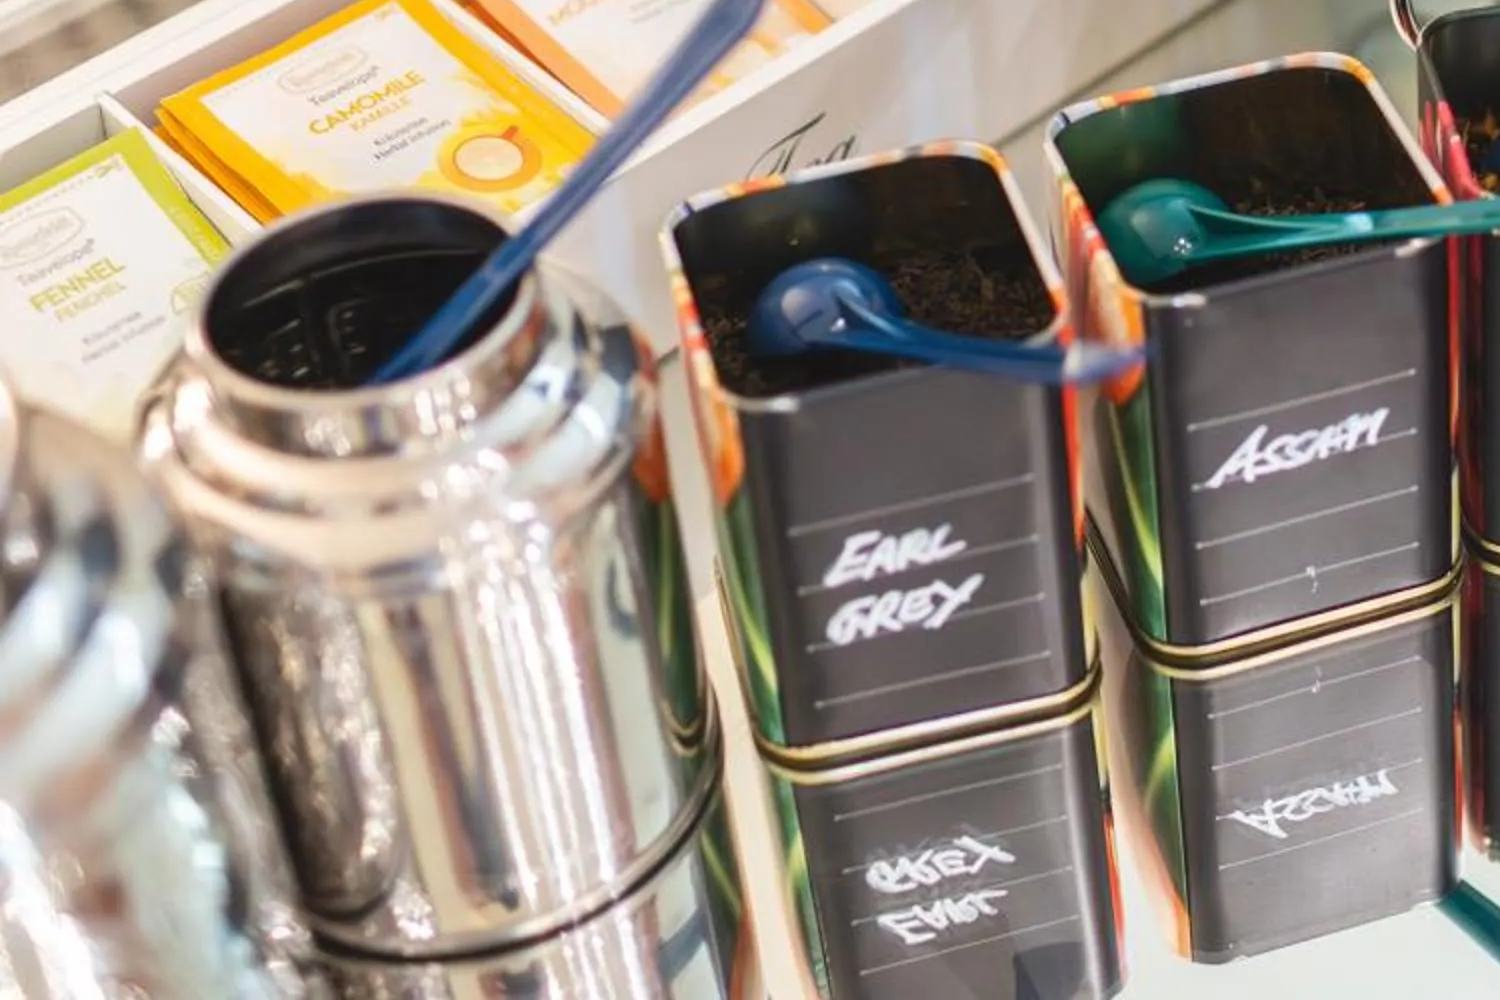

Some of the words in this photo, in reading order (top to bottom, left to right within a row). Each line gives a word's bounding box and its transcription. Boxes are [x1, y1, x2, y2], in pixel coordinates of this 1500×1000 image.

[309, 70, 426, 135] CAMOMILE
[29, 256, 126, 313] FENNEL
[1205, 407, 1390, 489] ASSAM
[823, 521, 967, 588] EARL
[826, 573, 985, 646] GREY
